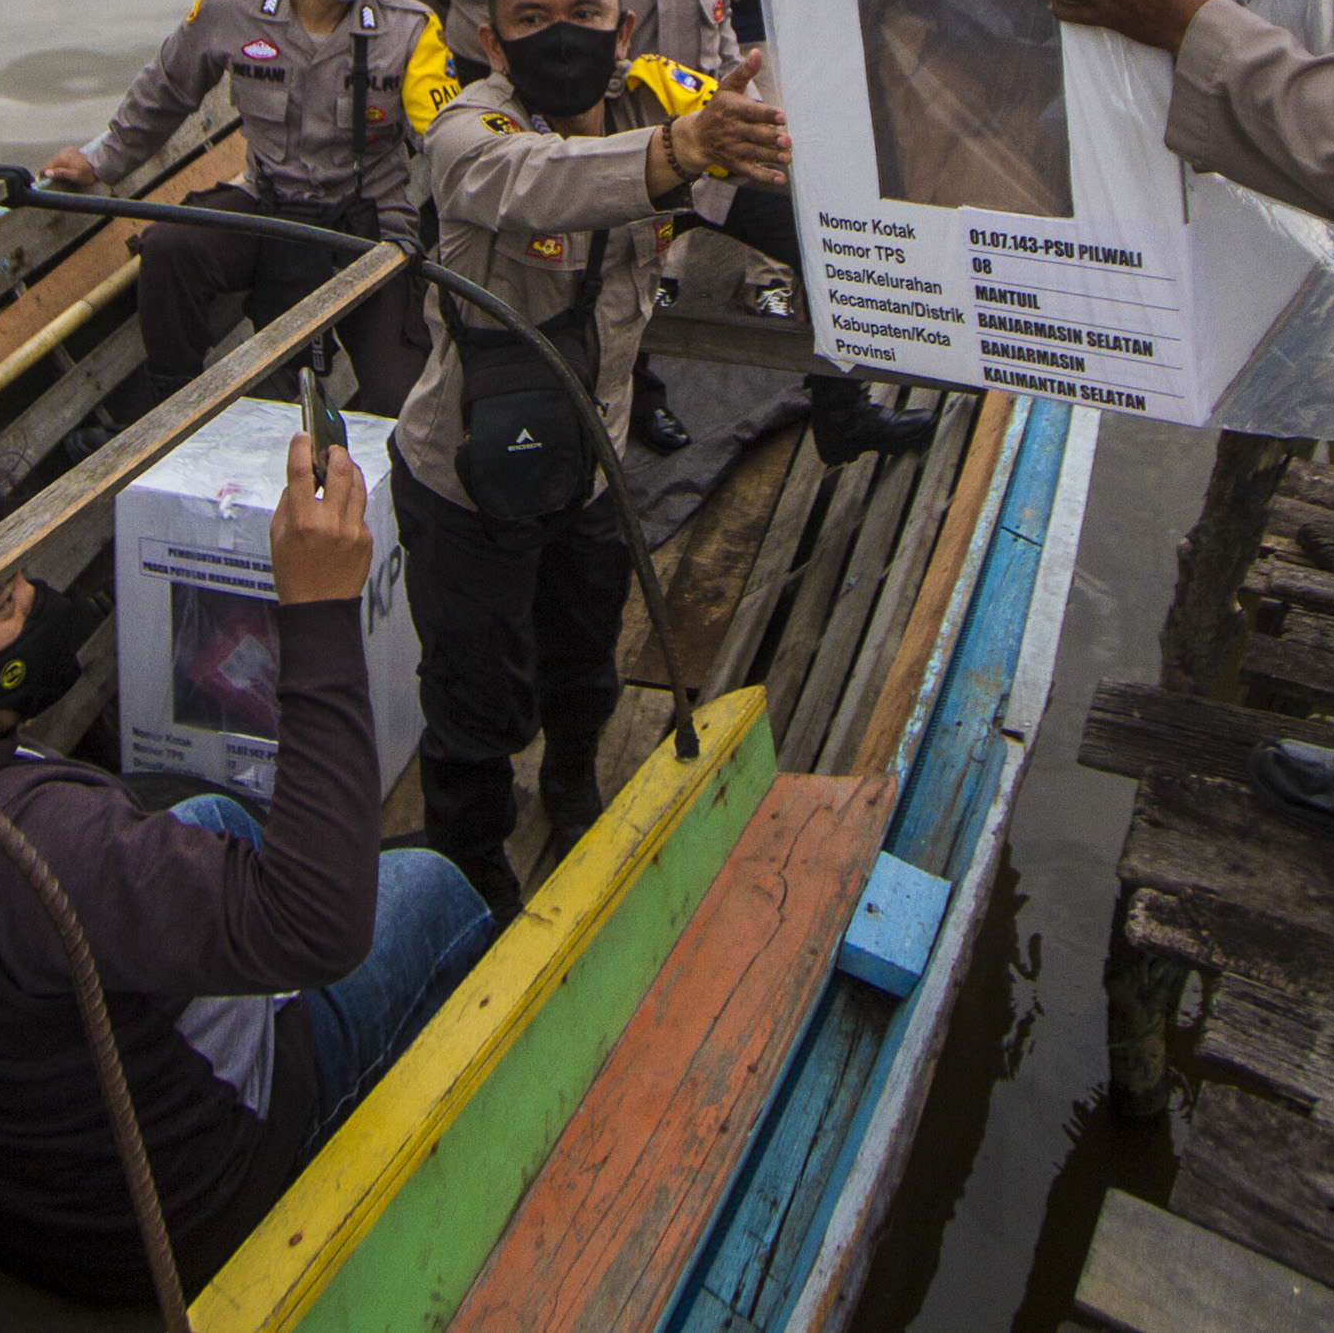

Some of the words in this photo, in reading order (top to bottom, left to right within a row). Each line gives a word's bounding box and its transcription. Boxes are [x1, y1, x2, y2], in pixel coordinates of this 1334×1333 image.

[344, 74, 400, 92] PLRI
[819, 211, 868, 232] Nomor
[871, 218, 916, 240] Kotak
[822, 237, 871, 259] Nomor
[874, 245, 906, 264] TPS
[969, 228, 1075, 259] 01.07.143-PSU
[1078, 243, 1143, 268] PILWALI
[825, 263, 943, 295] Desa/Kelurahan
[972, 256, 993, 275] 08
[828, 288, 966, 324] Kecamatan/Distrik
[974, 284, 1041, 310] MANTUIL
[831, 314, 951, 347] Kabupaten/Kota
[977, 312, 1083, 345] BANJARMASIN
[1086, 330, 1154, 358] SELATAN
[835, 338, 897, 362] Provinsi
[980, 339, 1086, 373] BANJARMASIN
[983, 366, 1077, 399] KALIMANTAN
[1080, 384, 1147, 411] SELATAN
[252, 561, 273, 573] ULAN
[368, 544, 403, 638] KP
